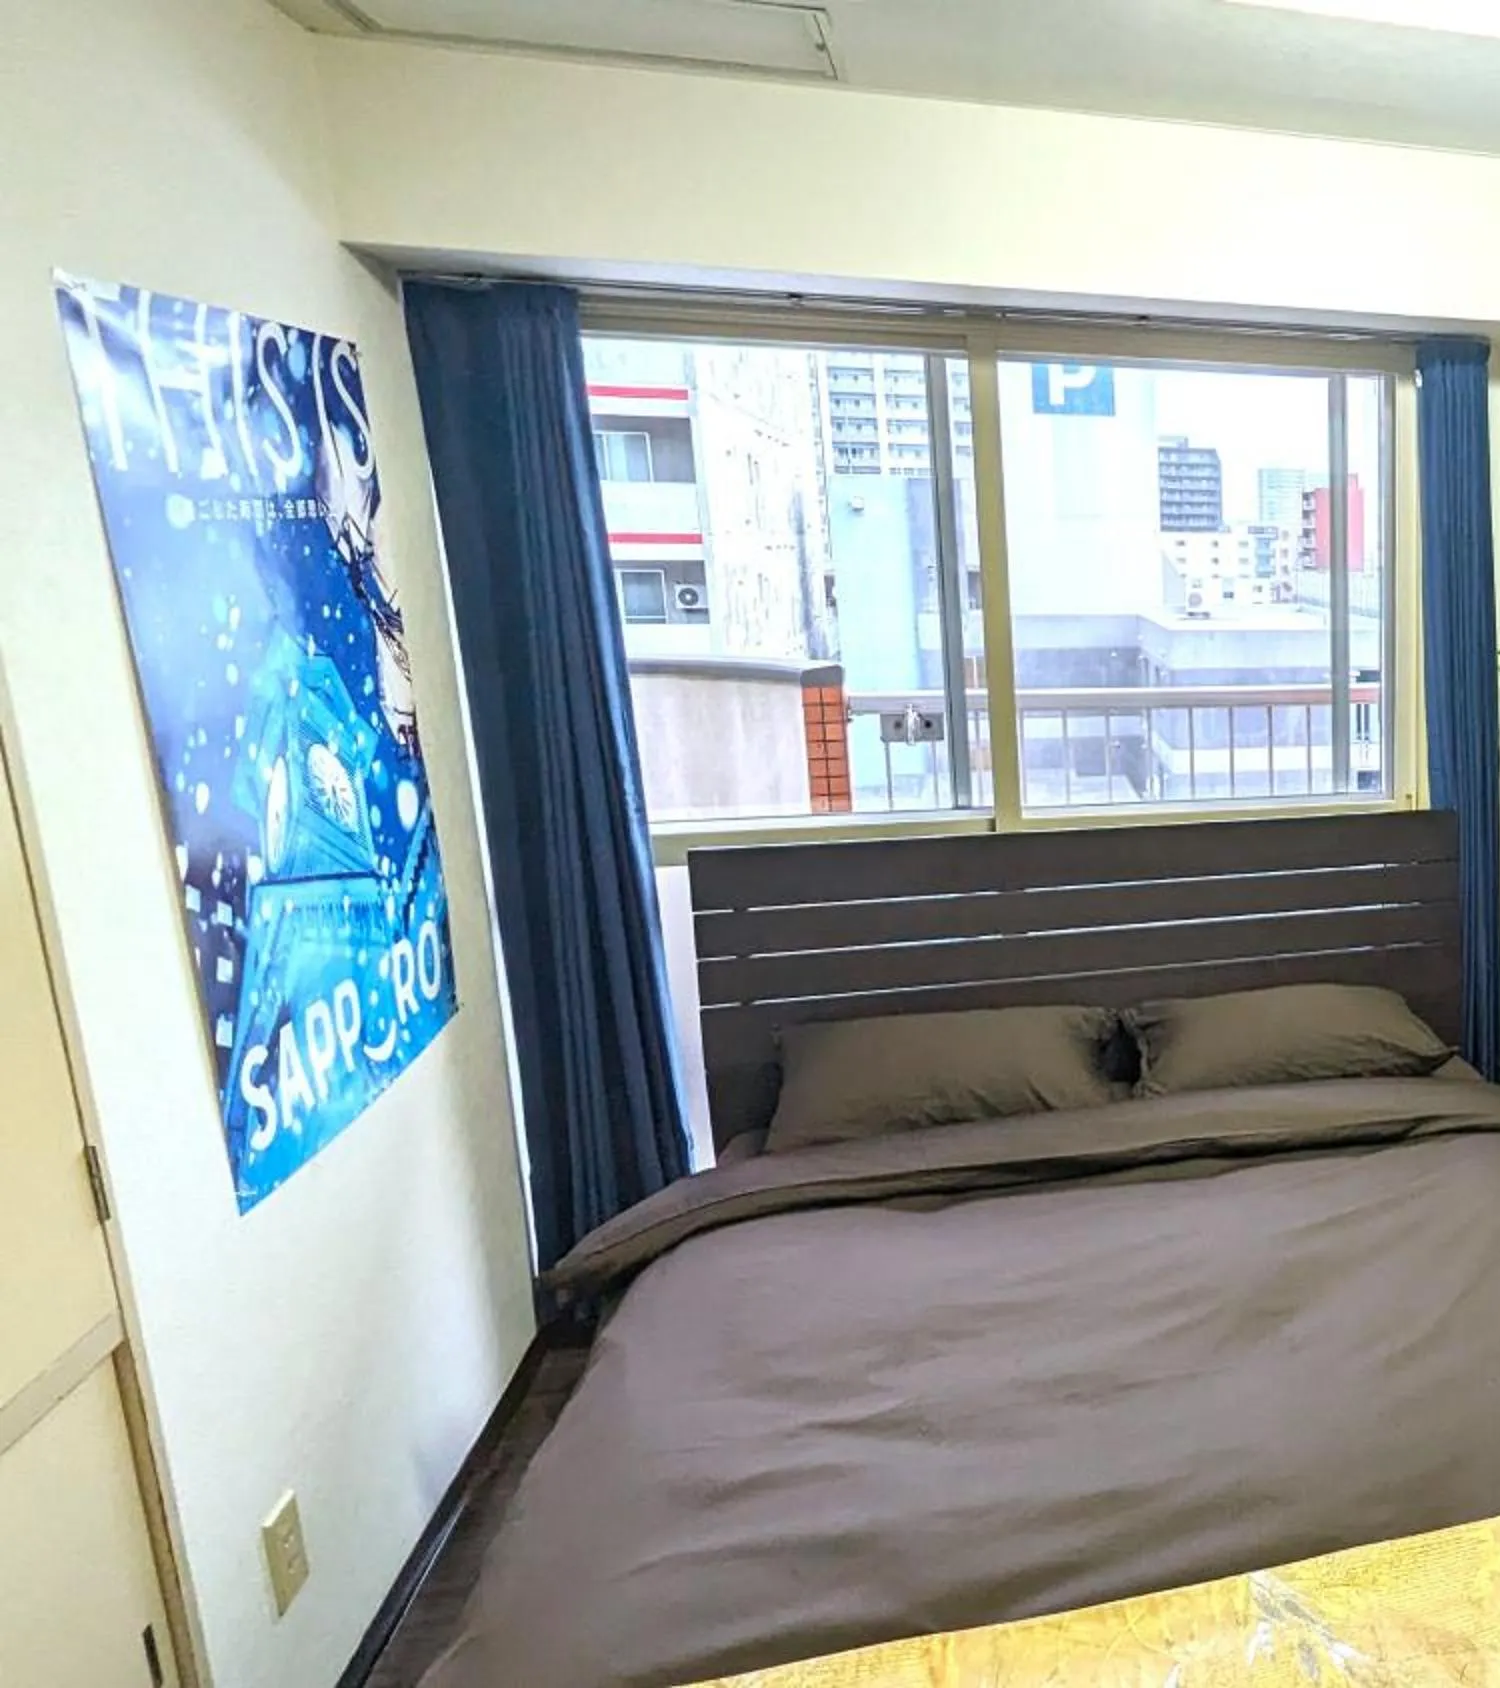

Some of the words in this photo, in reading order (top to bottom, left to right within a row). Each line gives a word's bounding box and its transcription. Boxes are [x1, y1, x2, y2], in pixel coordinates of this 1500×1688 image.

[54, 270, 302, 480] THIS
[313, 332, 375, 481] IS
[1047, 362, 1097, 406] P
